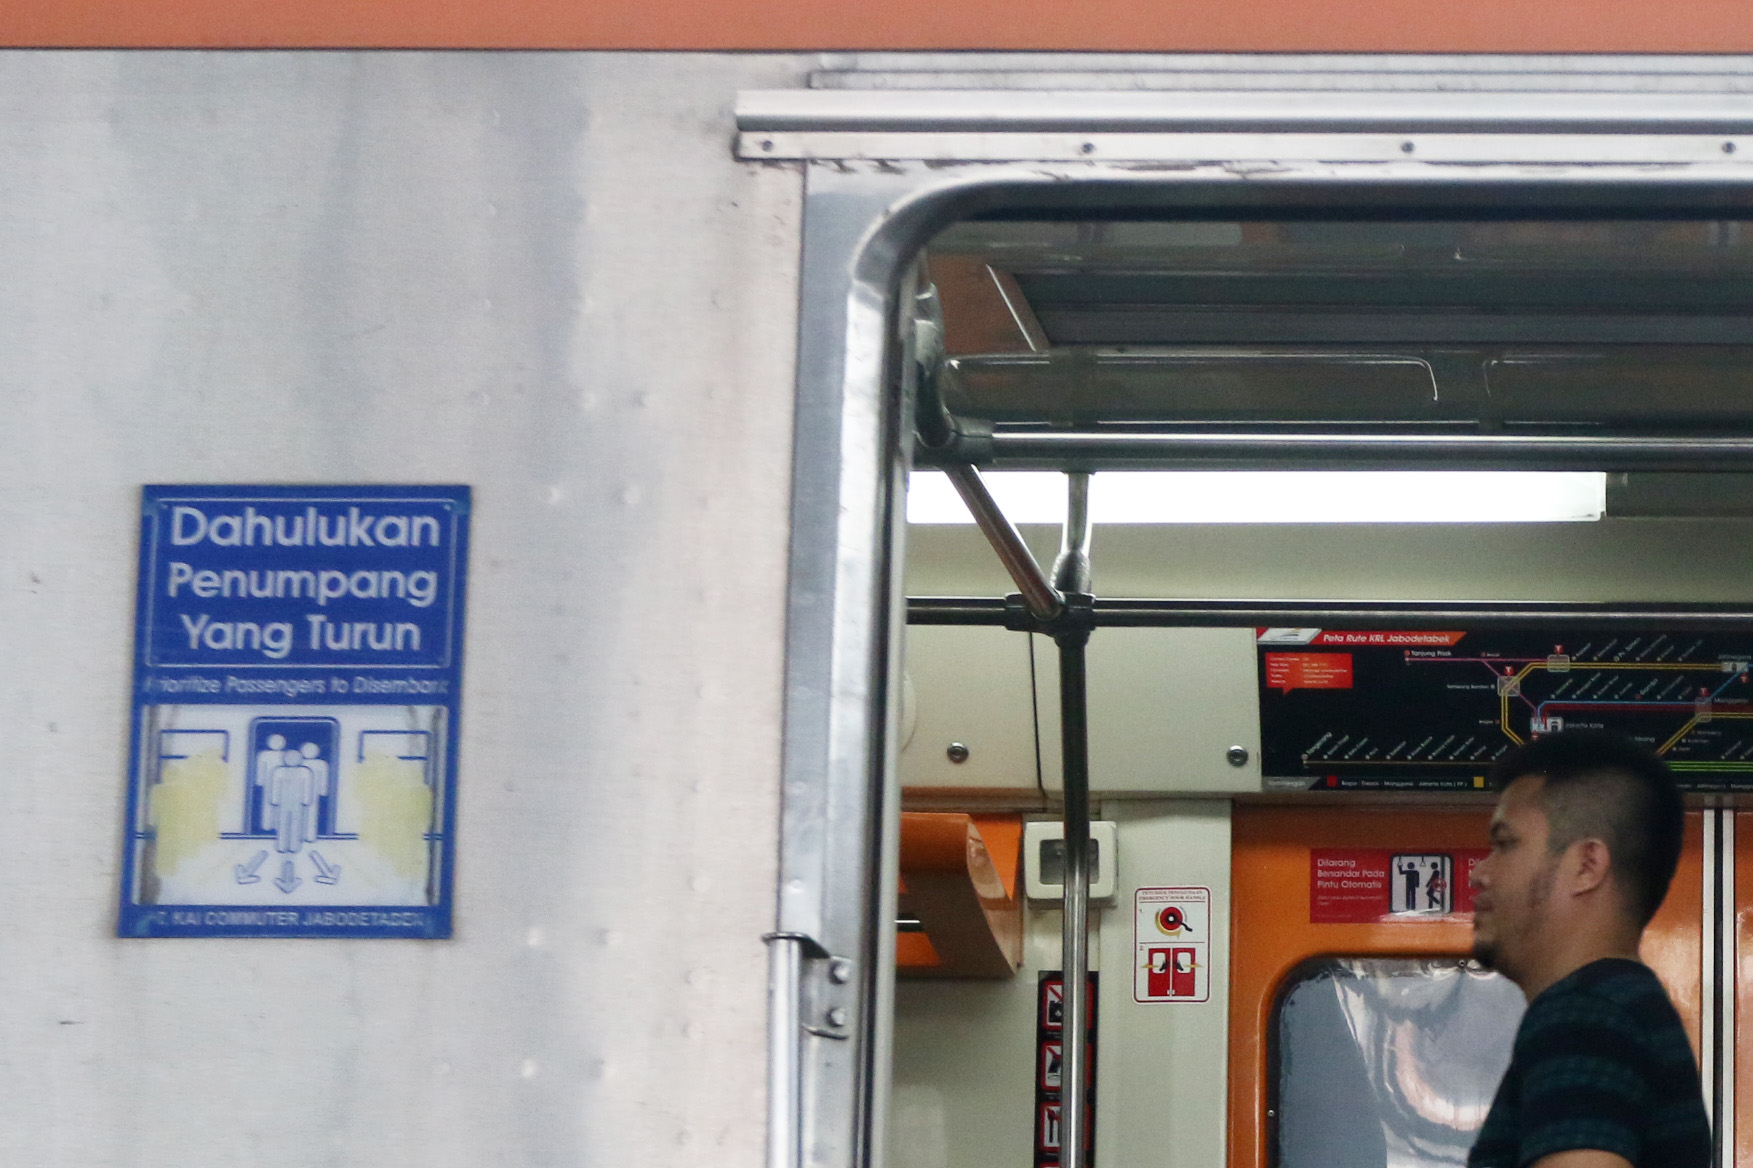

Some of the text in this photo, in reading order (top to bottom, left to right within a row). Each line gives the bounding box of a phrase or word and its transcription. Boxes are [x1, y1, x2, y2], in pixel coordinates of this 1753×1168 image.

[171, 506, 440, 547] Dahulukan
[167, 562, 437, 607] Penumpang
[180, 613, 421, 658] Yang Turun
[1323, 633, 1450, 643] Peta Rute KRL Jabodetabek
[225, 676, 326, 697] Passengers
[330, 676, 350, 692] to
[1317, 859, 1355, 868] Dilarang
[1317, 880, 1382, 888] Pintu Otomatis
[205, 912, 299, 925] COMMUTER
